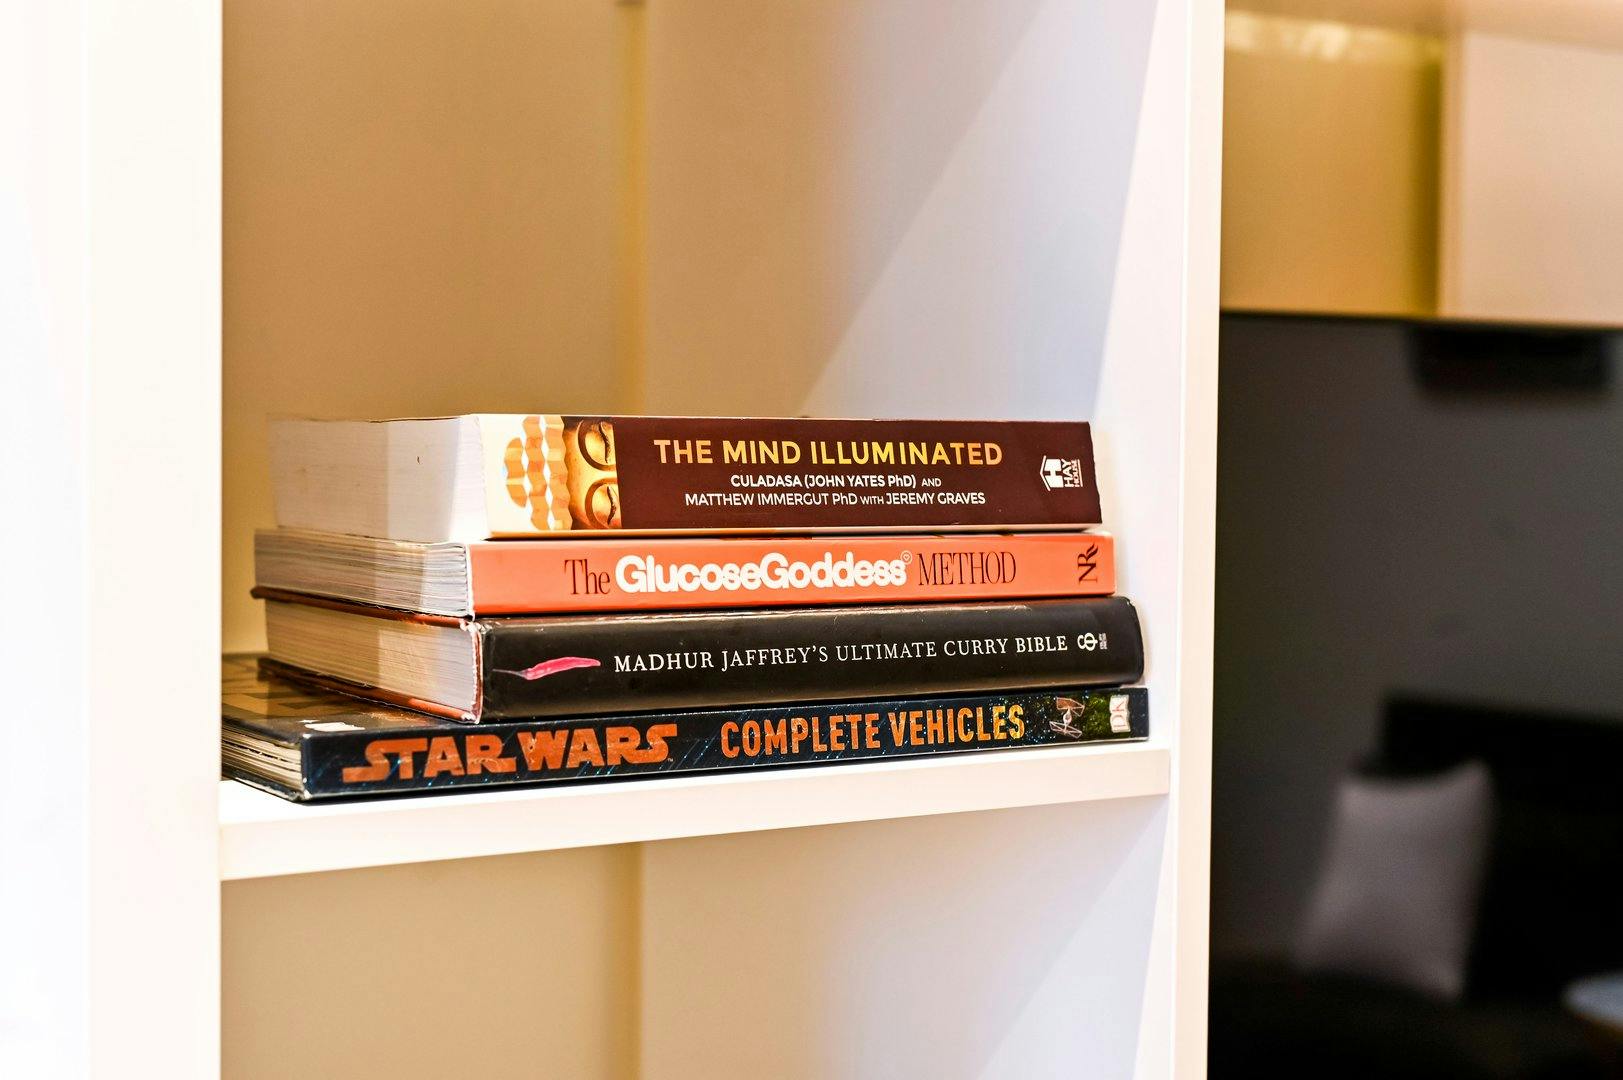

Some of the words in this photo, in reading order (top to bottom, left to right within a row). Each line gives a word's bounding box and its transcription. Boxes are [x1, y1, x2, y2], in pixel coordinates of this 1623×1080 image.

[653, 439, 713, 464] THE
[722, 440, 801, 465] MIND
[810, 441, 1003, 466] ILLUMINATED
[730, 475, 802, 488] CULADASA
[804, 474, 845, 489] (JOHN
[846, 475, 885, 488] YATES
[888, 474, 917, 489] PhD)
[921, 477, 942, 487] AND
[1061, 458, 1074, 487] HAY
[685, 493, 757, 506] MATTHEW
[757, 493, 828, 506] IMMERGUT
[832, 493, 858, 505] PhD
[860, 495, 884, 505] WITH
[886, 492, 934, 505] JEREMY
[937, 492, 986, 505] GRAVES
[564, 558, 611, 595] The
[615, 552, 907, 593] GlucoseGoddess
[917, 551, 1017, 586] METHOD
[614, 651, 714, 673] MADHUR
[721, 645, 829, 673] JAFFREY'S
[836, 641, 937, 662] ULTIMATE
[943, 638, 1009, 656] CURRY
[1015, 635, 1068, 653] BIBLE
[720, 713, 881, 758] COMPLETE
[888, 703, 1026, 747] VEHICLES
[342, 733, 517, 784] STAR
[517, 723, 678, 772] WARS
